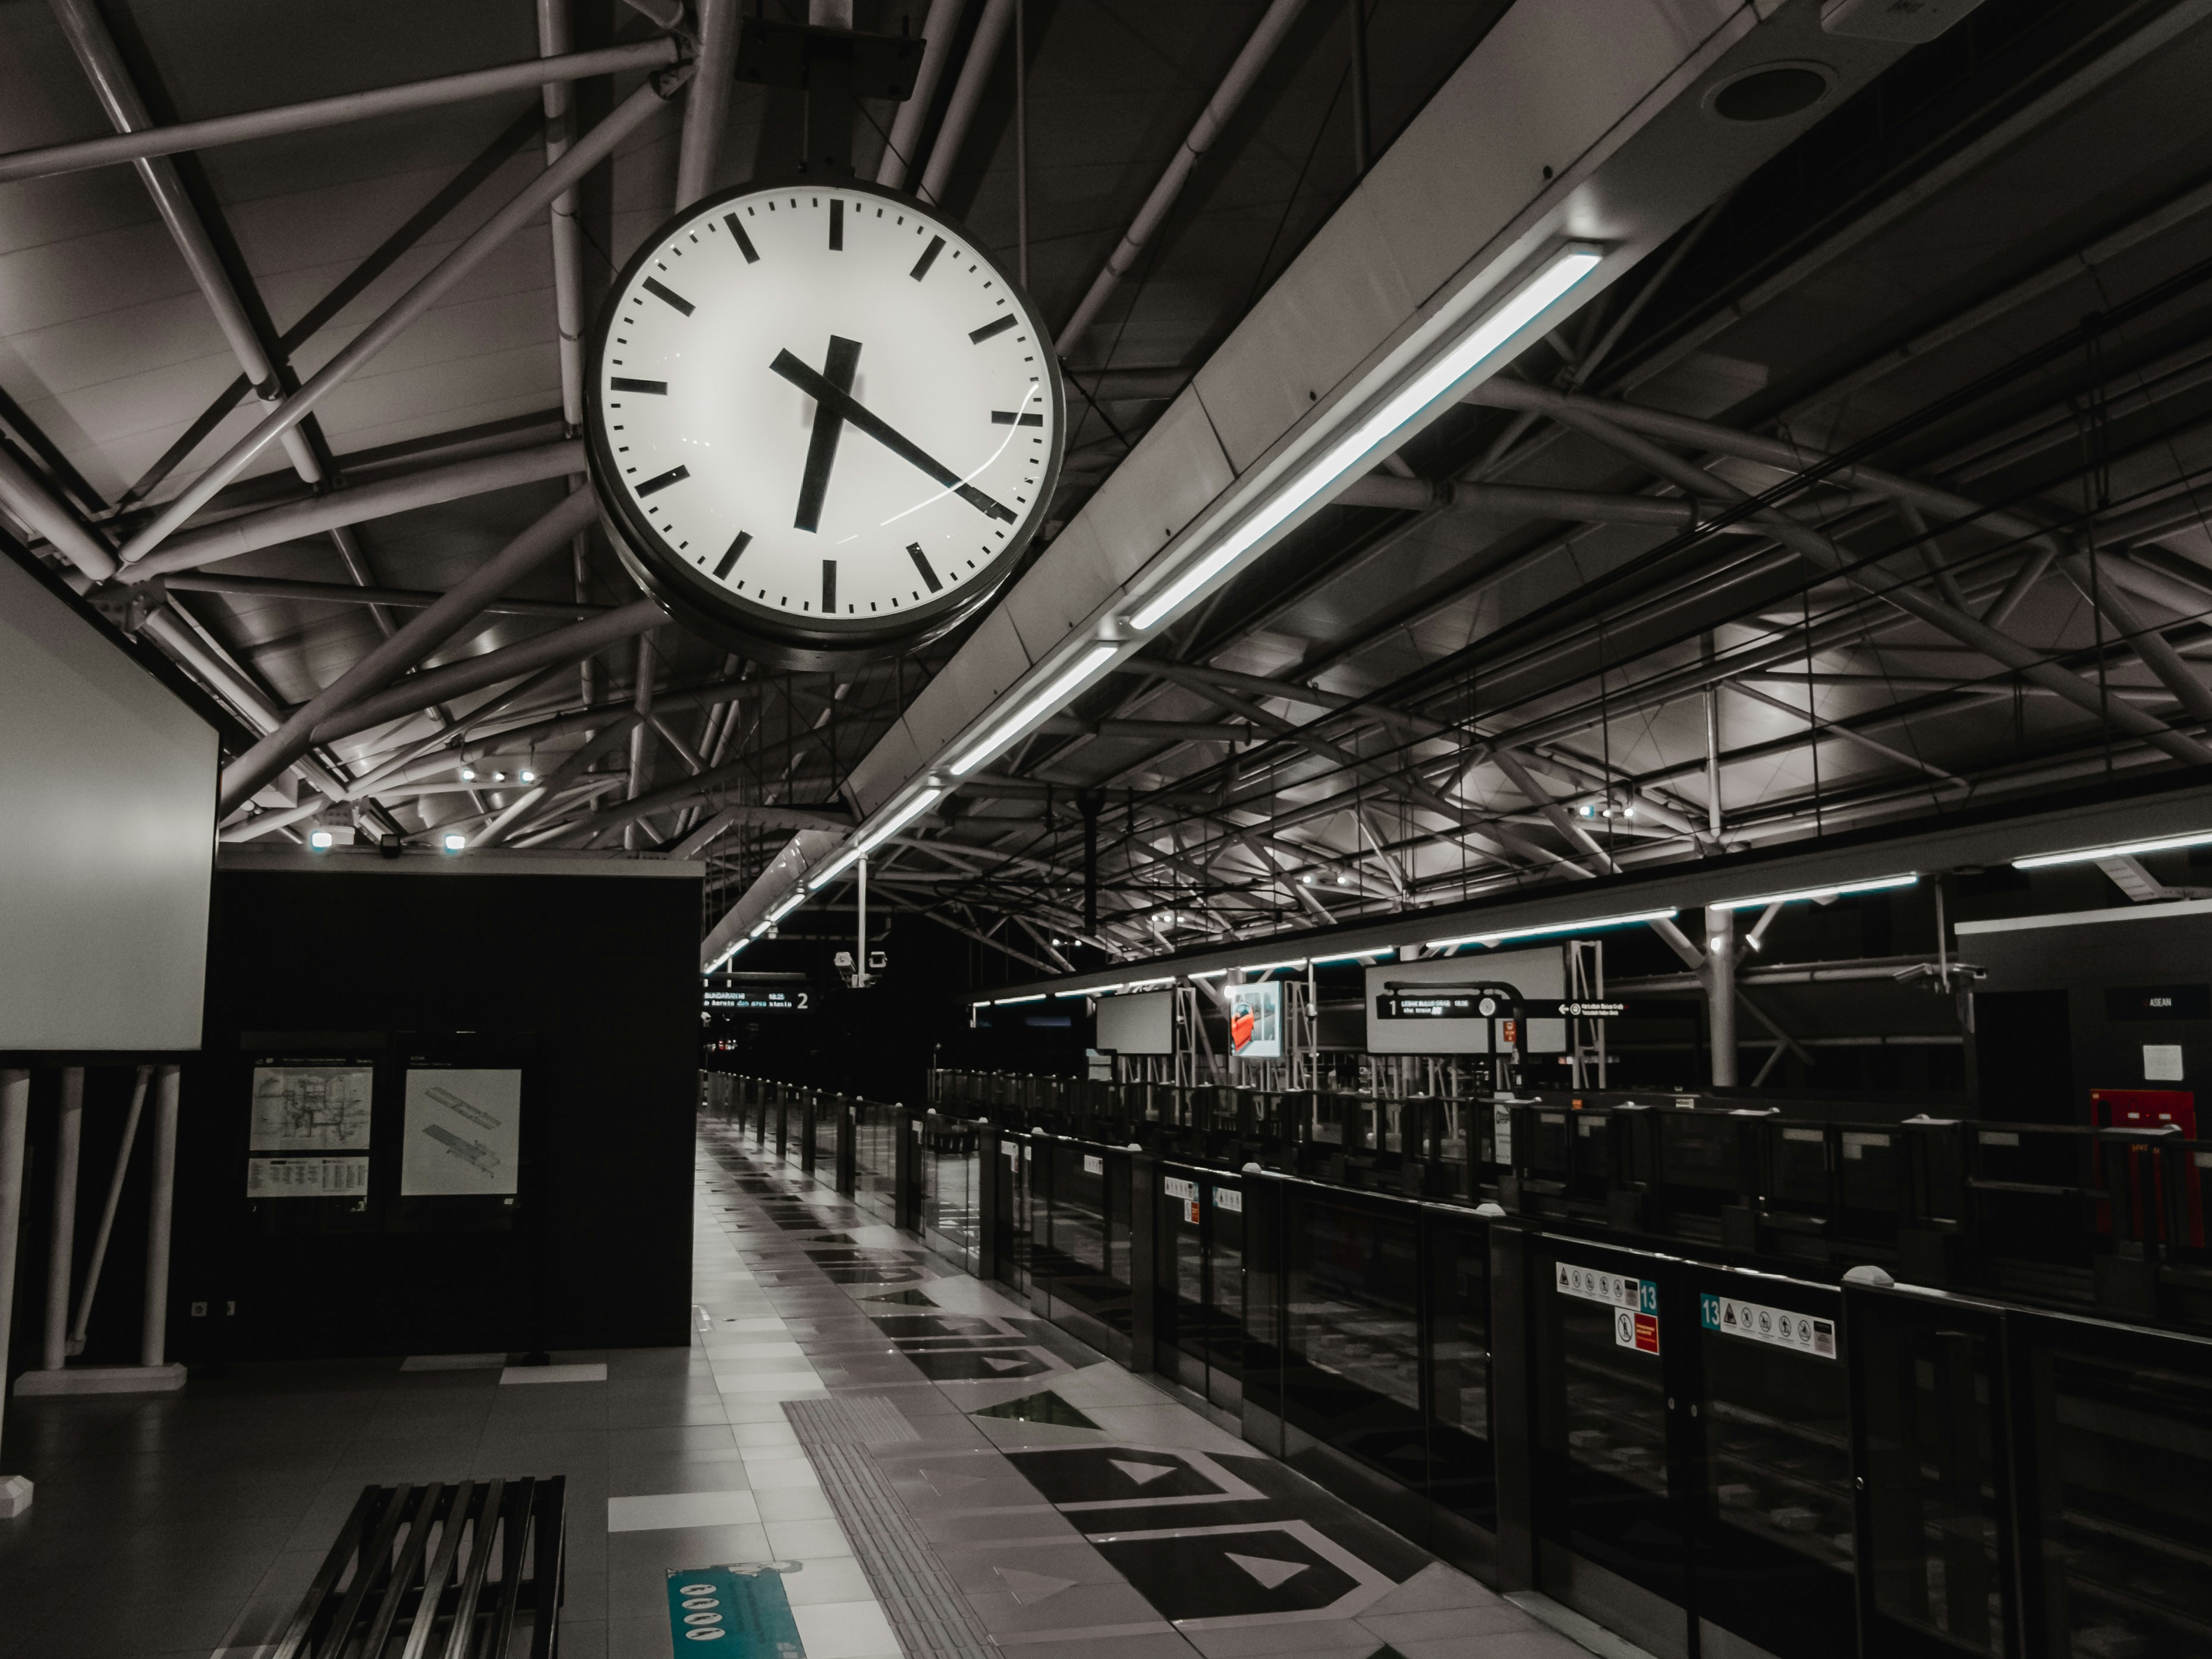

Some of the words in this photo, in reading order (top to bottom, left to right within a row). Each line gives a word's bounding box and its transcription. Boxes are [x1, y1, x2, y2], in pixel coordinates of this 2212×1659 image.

[797, 993, 808, 1009] 2
[1389, 1000, 1396, 1015] 1
[2150, 998, 2172, 1007] ASEAN
[1641, 1285, 1657, 1310] 13
[1703, 1299, 1720, 1326] 13
